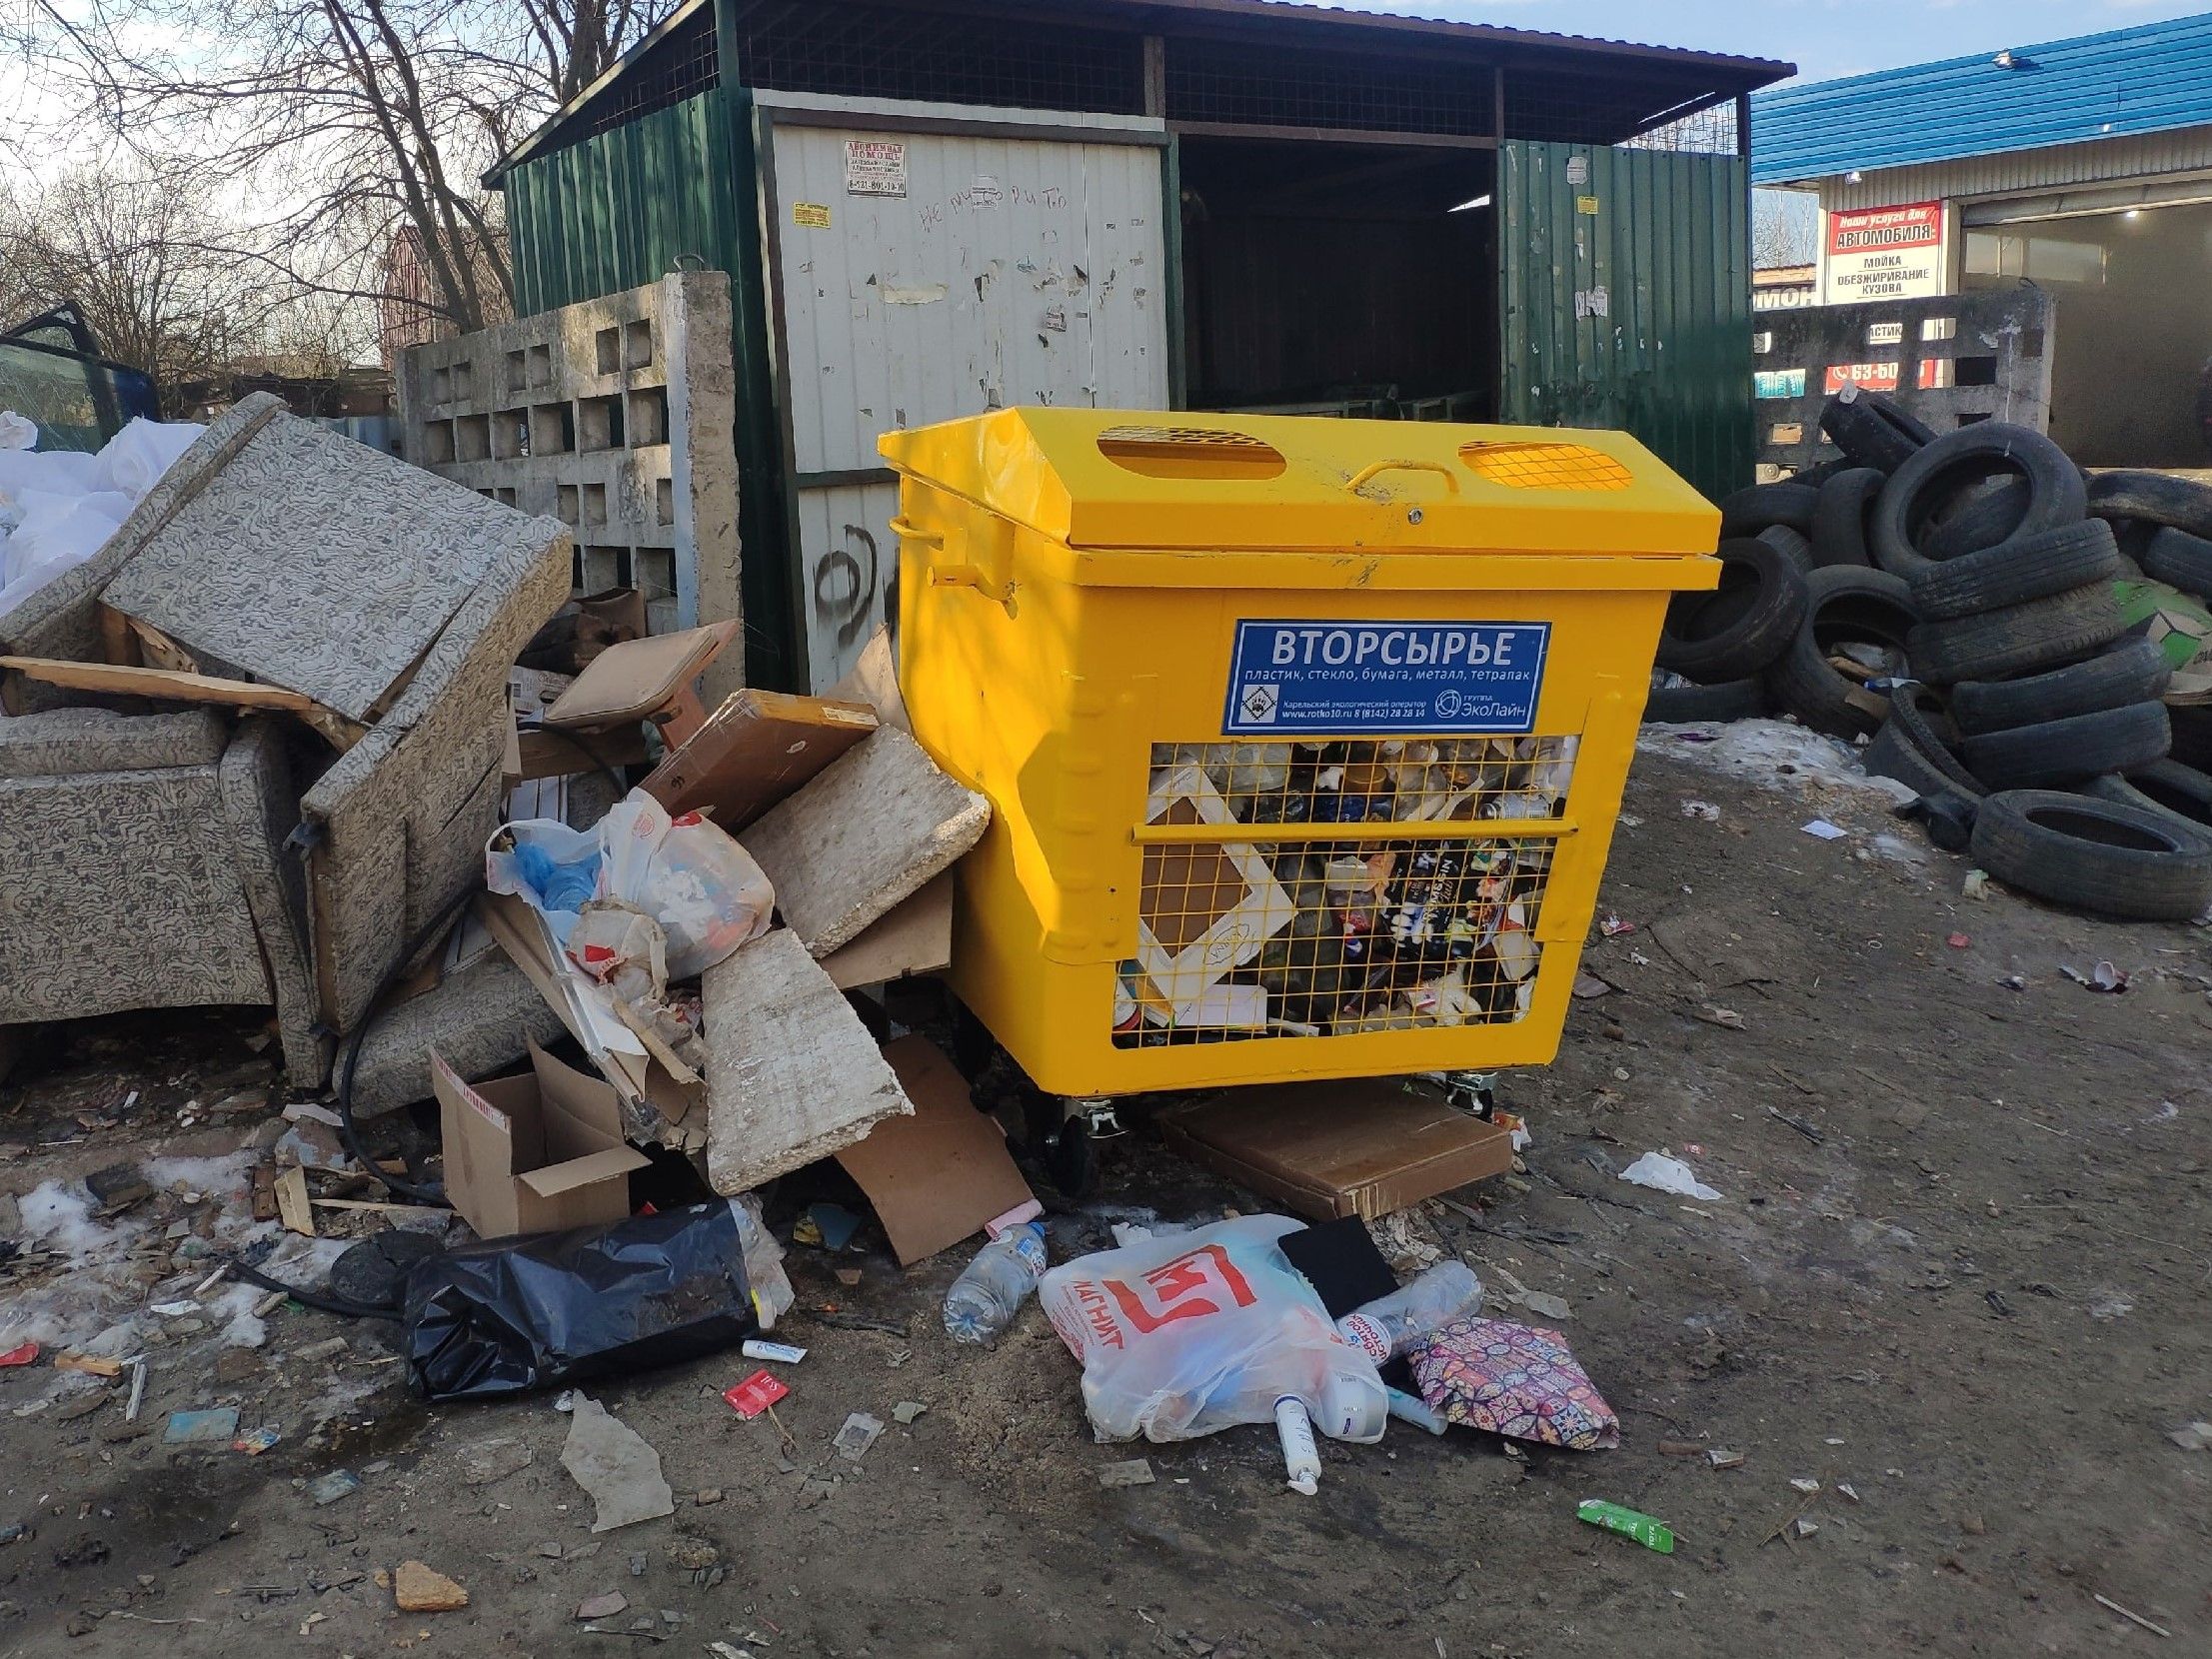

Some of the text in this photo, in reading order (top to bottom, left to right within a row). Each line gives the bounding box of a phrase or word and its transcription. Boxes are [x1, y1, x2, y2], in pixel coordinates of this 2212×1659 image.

[1868, 211, 1906, 228] услуги
[1907, 208, 1928, 221] для
[1863, 255, 1902, 269] МОЙКА
[1837, 269, 1930, 286] ОБЕЗЖИРИВАНИЕ
[1862, 283, 1902, 295] КУЗОВА
[1271, 630, 1516, 666] ВТОРСЫРЬЕ
[1244, 667, 1530, 683] пластик, стекло, бумага, металл, тетрапак
[1282, 700, 1427, 710] Карельский экологический оператор
[1461, 703, 1526, 718] ЭкоЛайн
[1353, 709, 1360, 718] 8
[1361, 709, 1389, 719] (8142)
[1390, 709, 1400, 718] 28
[1402, 709, 1413, 718] 28
[1414, 709, 1425, 718] 14
[1070, 1280, 1124, 1350] МАГНИТ
